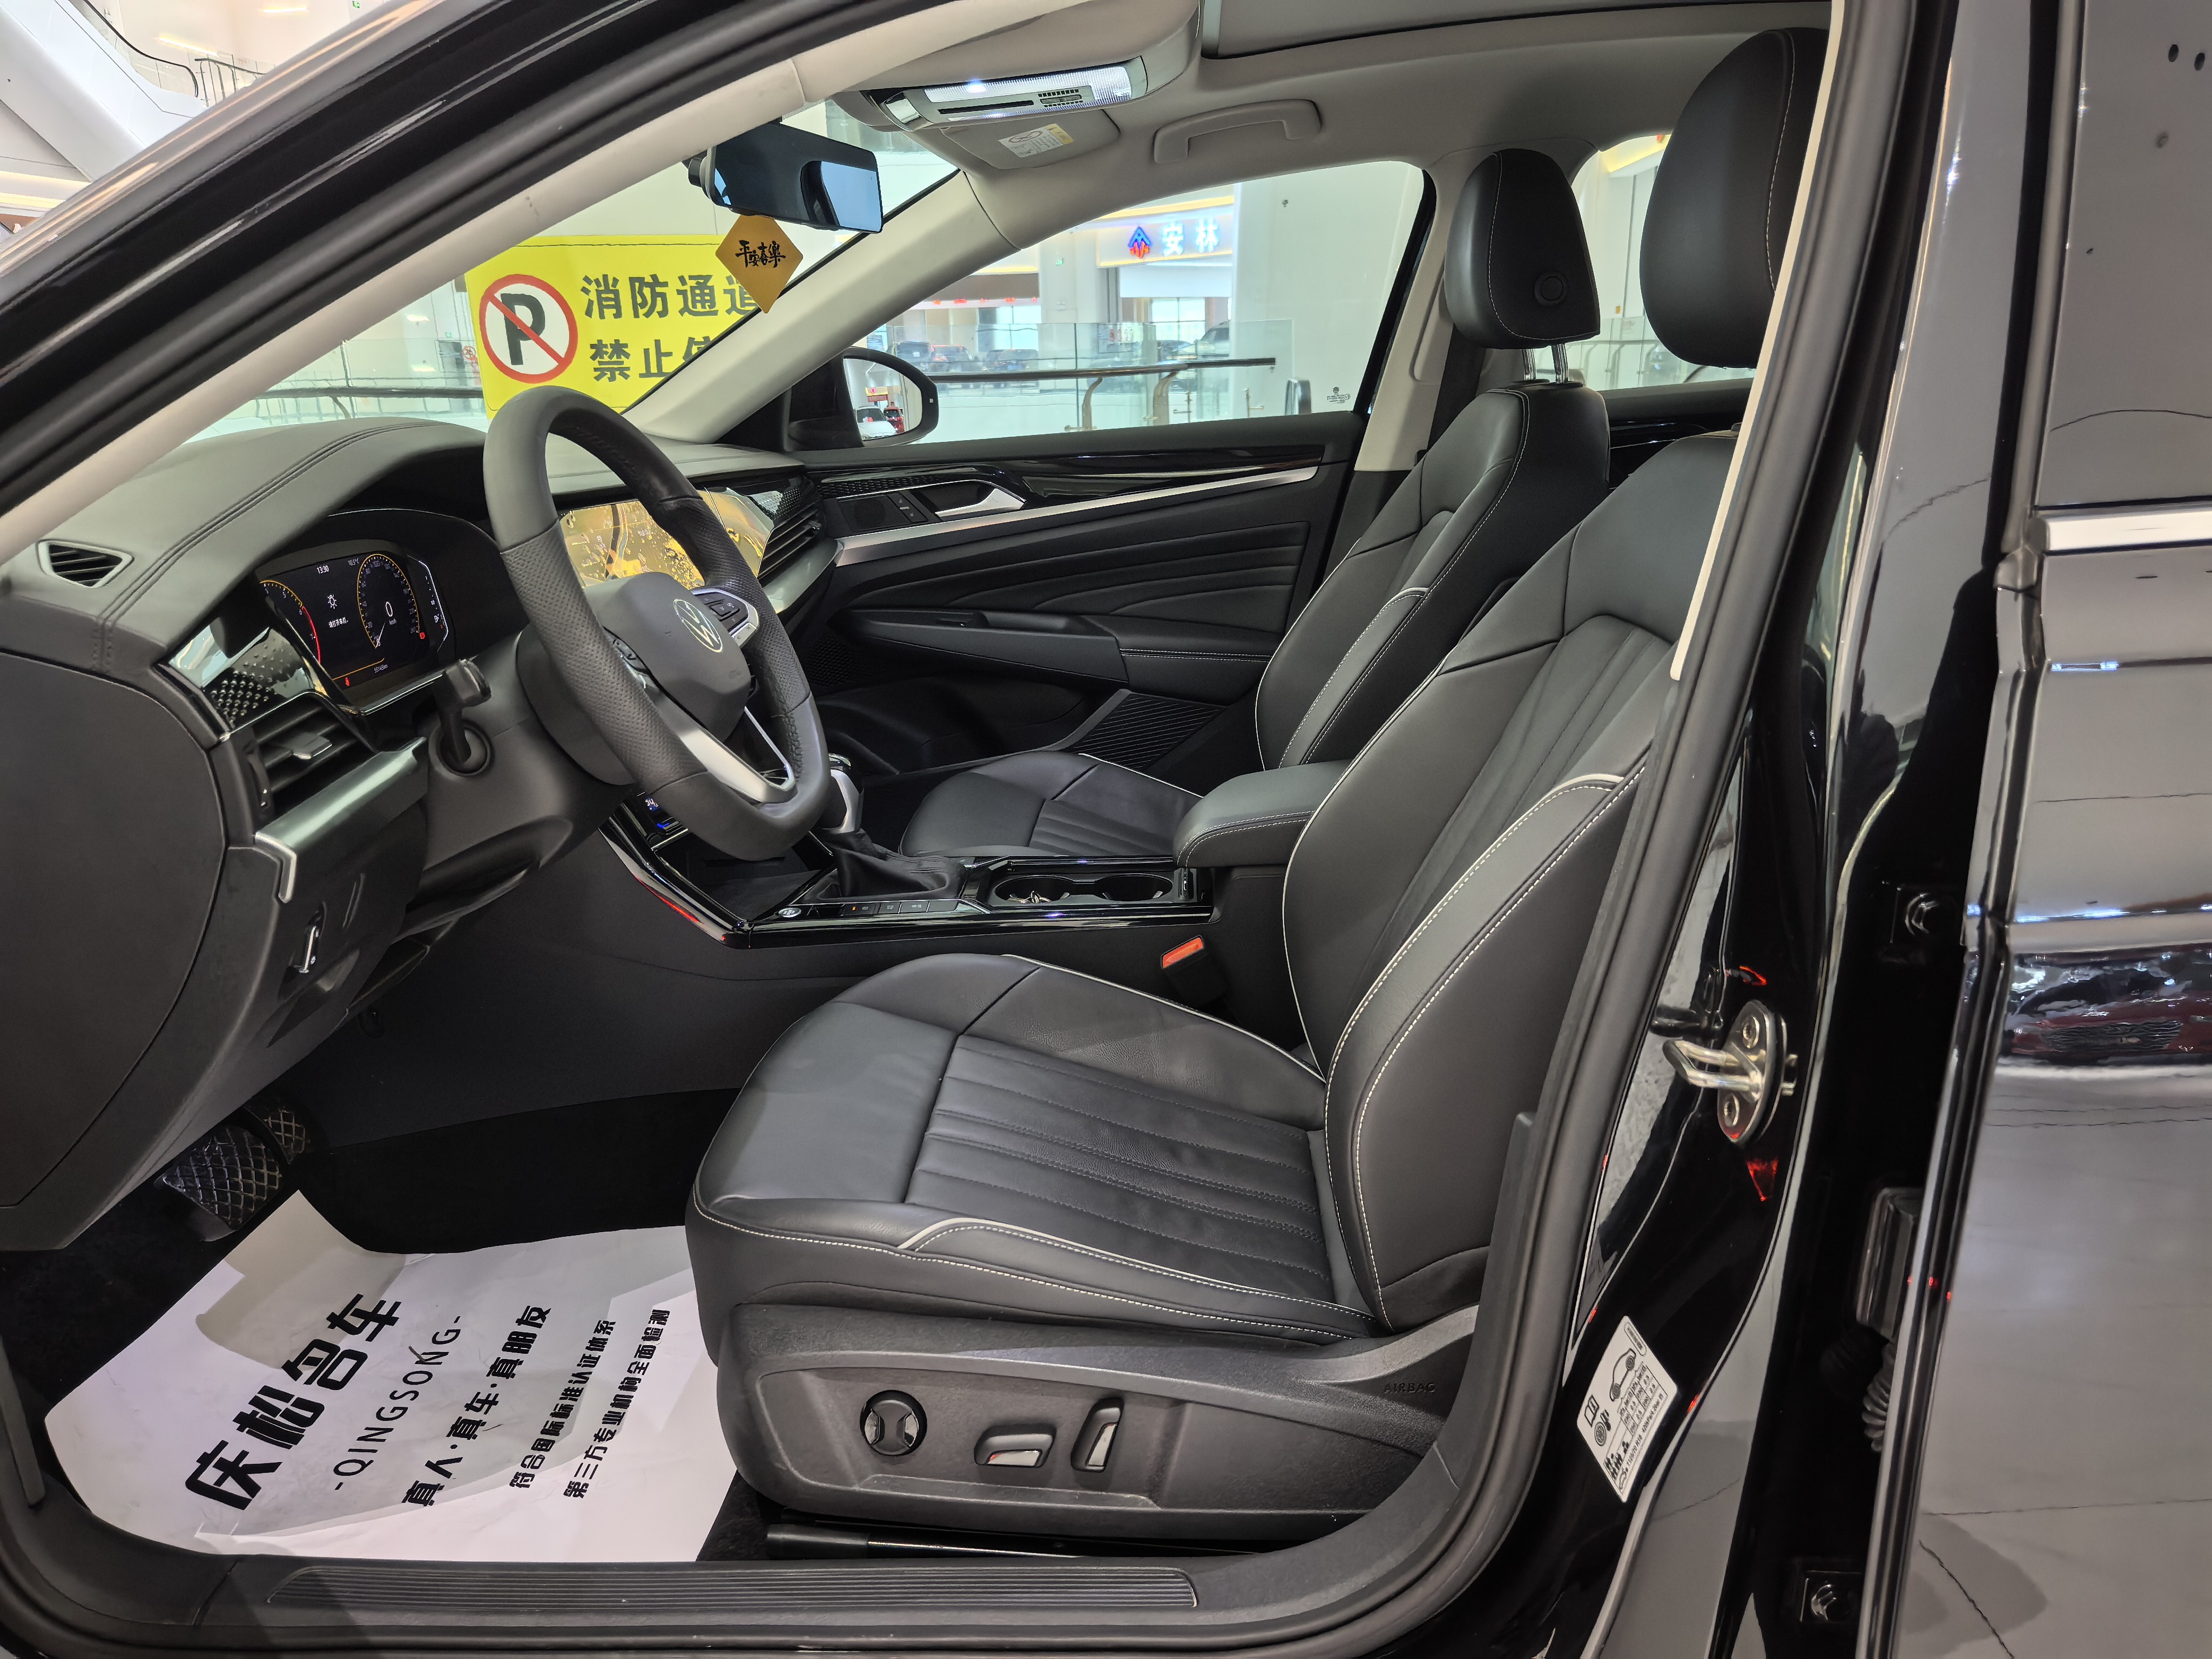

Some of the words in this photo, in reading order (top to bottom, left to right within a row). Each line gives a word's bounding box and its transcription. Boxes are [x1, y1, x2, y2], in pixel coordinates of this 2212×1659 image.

[1162, 217, 1219, 257] 安林
[185, 1293, 402, 1510] 庆松名车
[509, 1320, 616, 1488] 符合国际标准认证体系
[563, 1309, 670, 1499] 第三方专业机构全面检测
